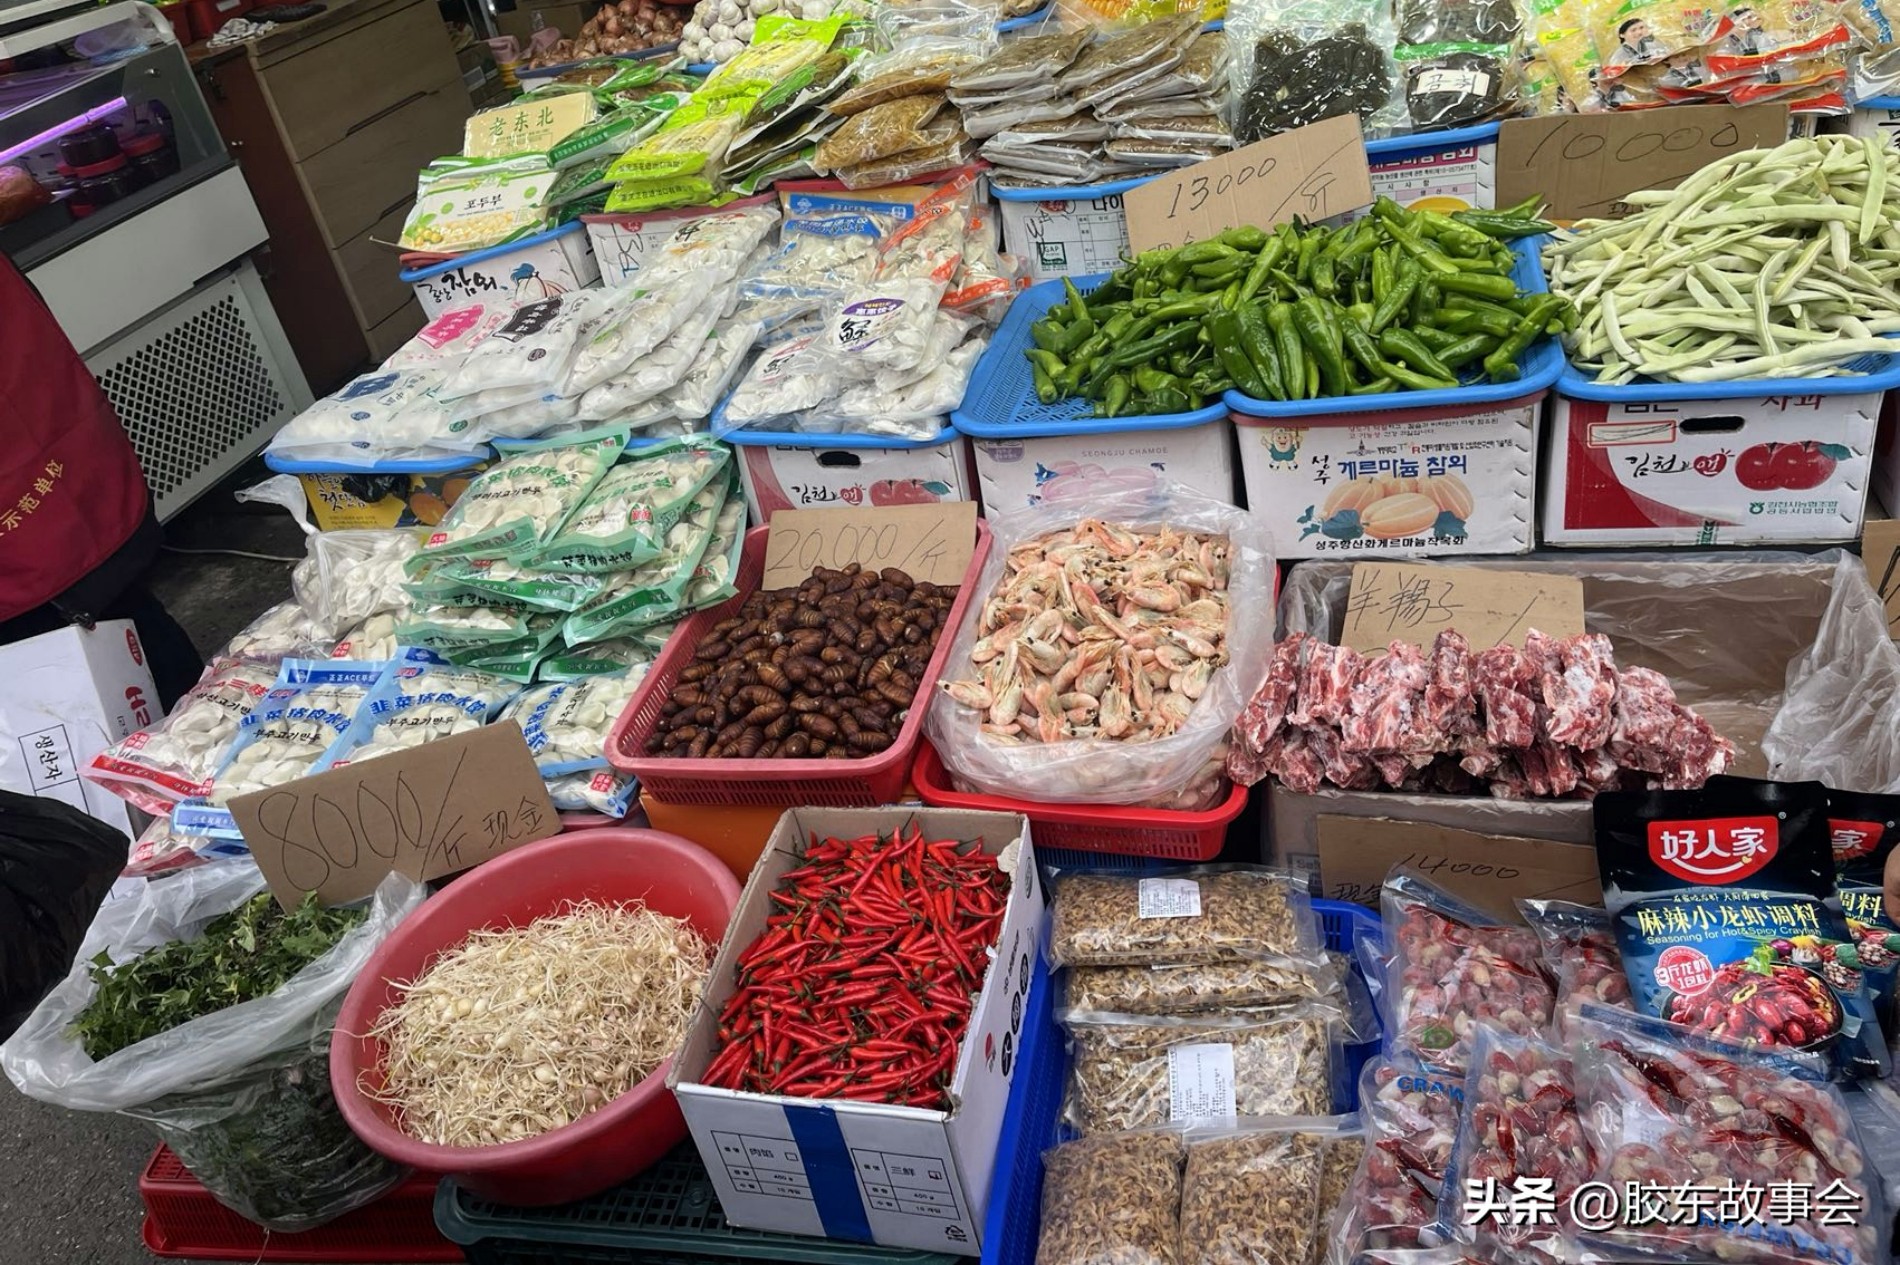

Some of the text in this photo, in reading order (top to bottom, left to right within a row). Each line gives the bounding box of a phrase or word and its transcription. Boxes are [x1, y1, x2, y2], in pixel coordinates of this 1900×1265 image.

[489, 106, 555, 137] 老东北
[1129, 447, 1169, 455] CHAMOE
[1338, 454, 1467, 481] 게르마늄 참외
[0, 459, 63, 535] 示范单位
[35, 734, 63, 781] 생산자
[1660, 827, 1768, 860] 好人家
[1637, 903, 1820, 936] 麻辣小龙虾调料
[1647, 926, 1822, 945] Seasoning for Hot&Spicy Crayfish
